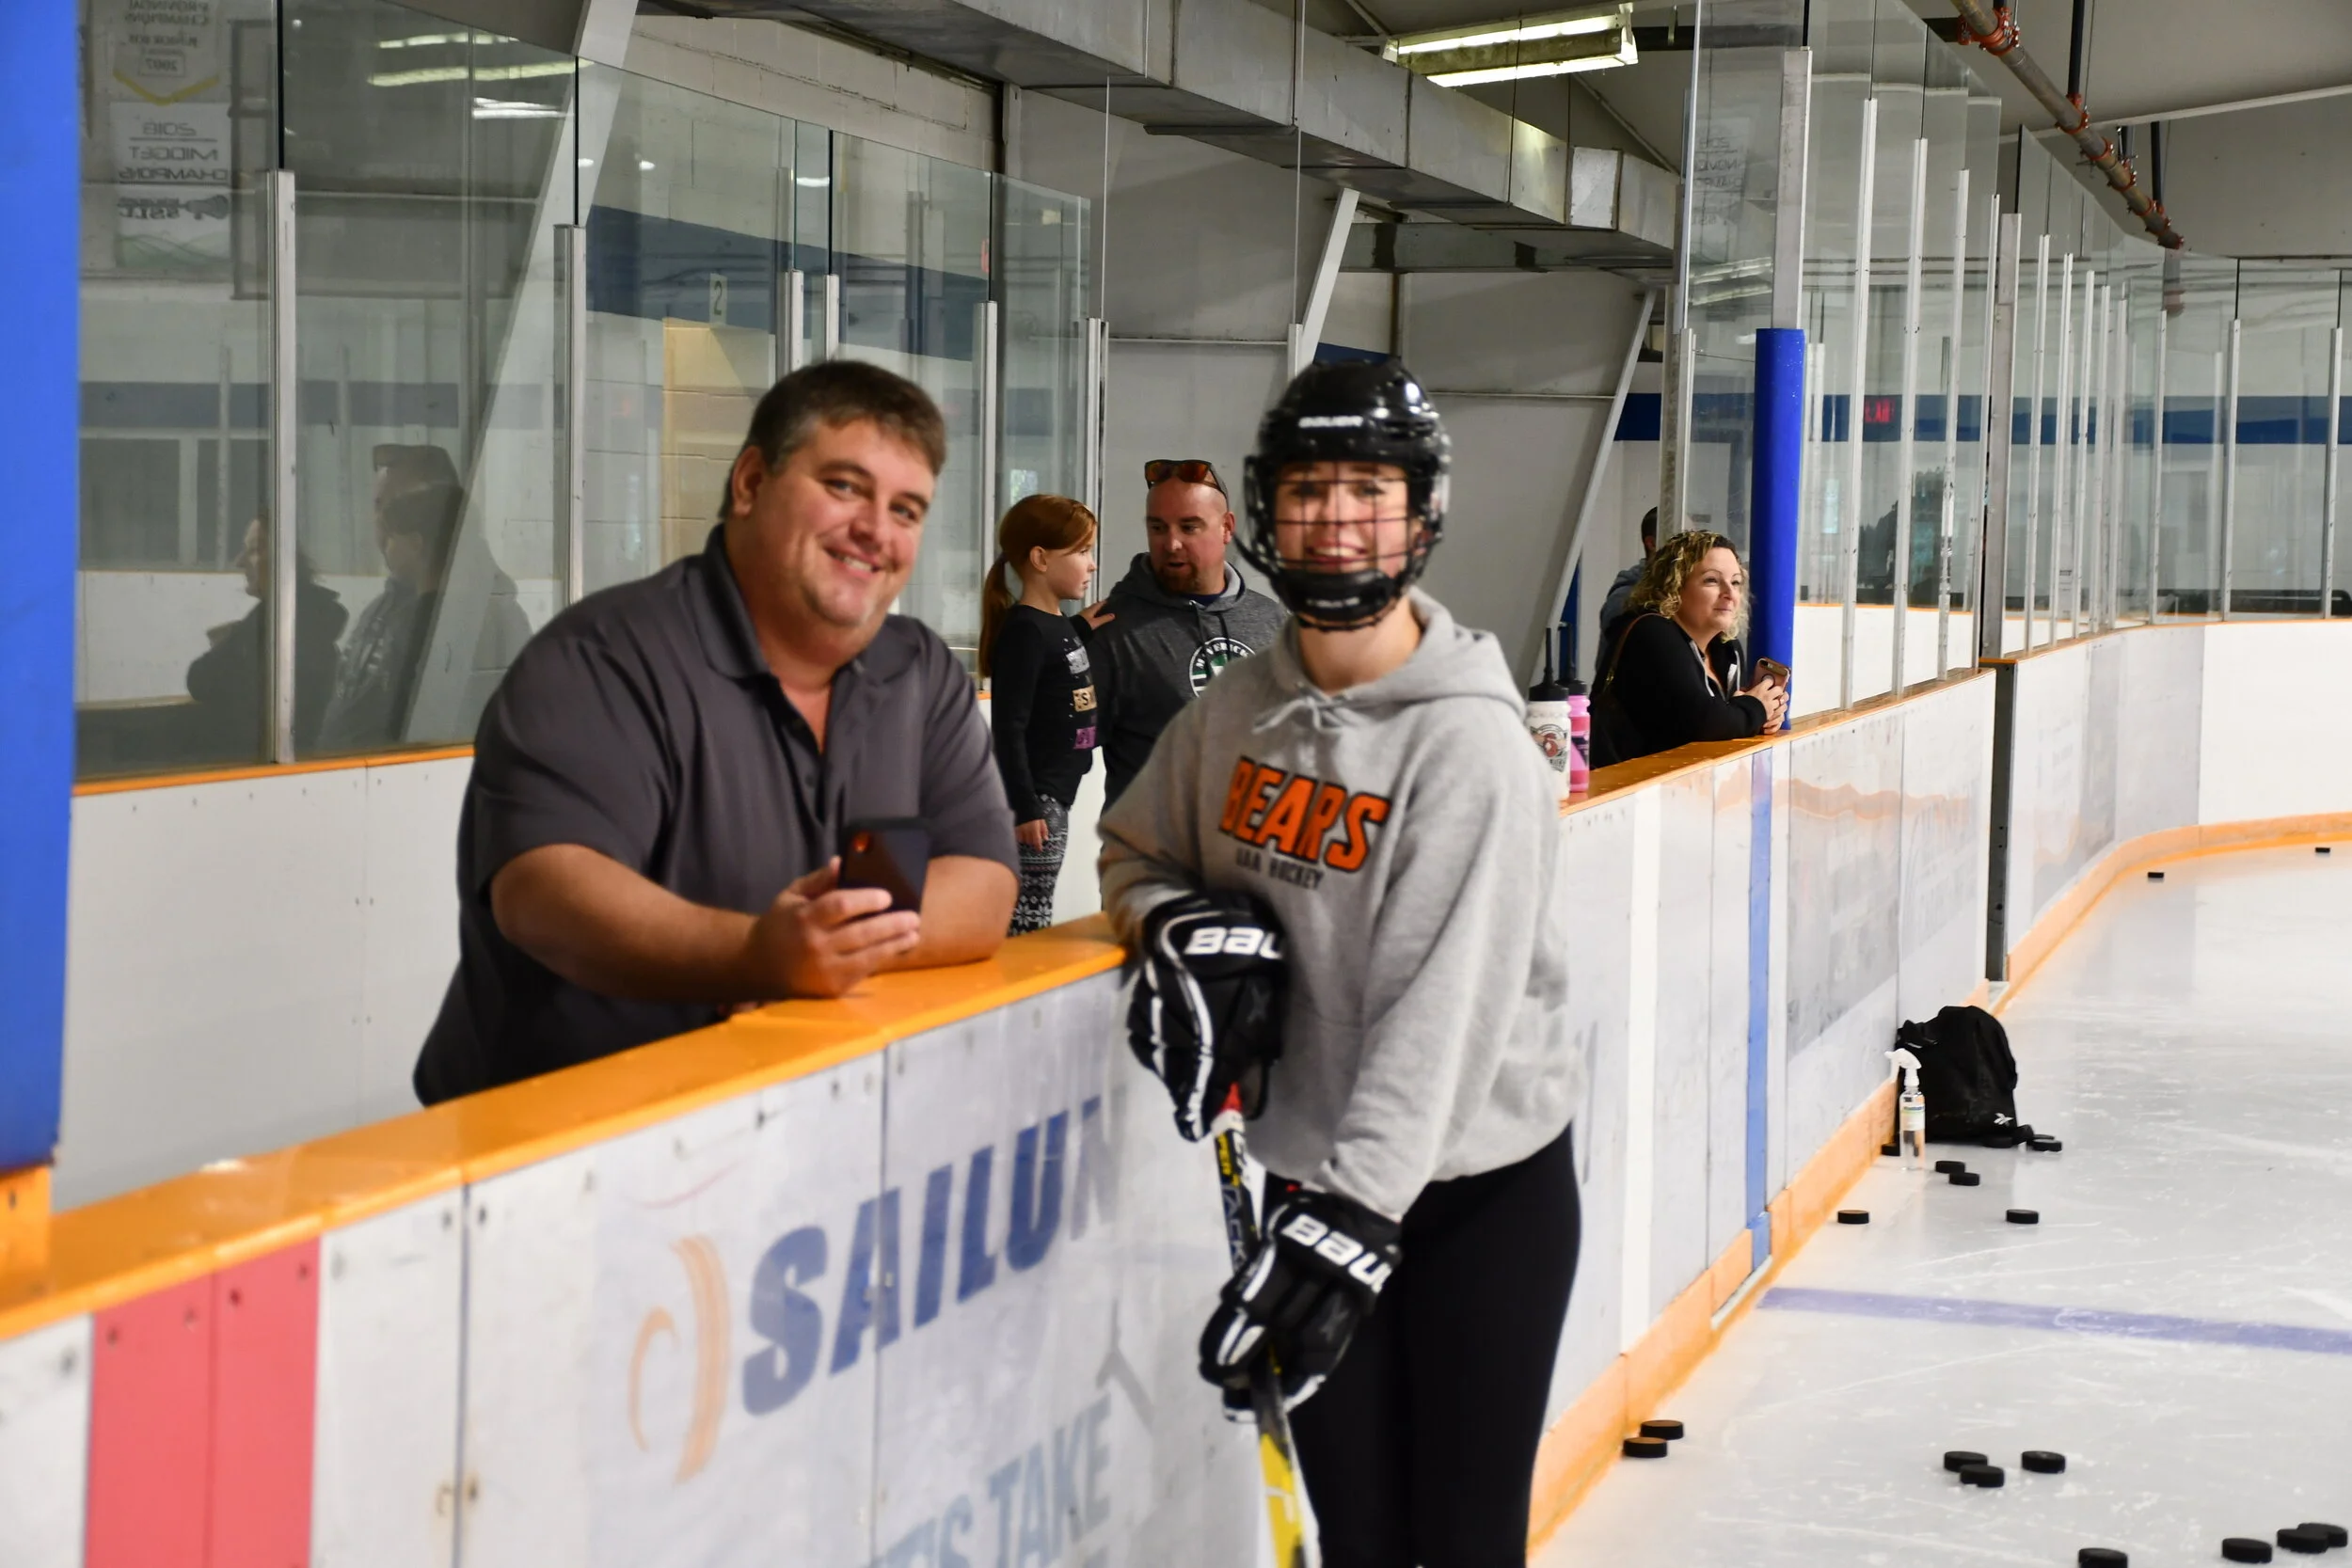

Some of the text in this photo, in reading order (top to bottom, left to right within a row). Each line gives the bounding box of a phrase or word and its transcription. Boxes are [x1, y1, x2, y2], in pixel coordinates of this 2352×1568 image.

[713, 279, 723, 316] 2
[1218, 754, 1392, 874] BEARS
[1267, 858, 1325, 890] HOCKEY
[988, 1390, 1112, 1568] TAKE
